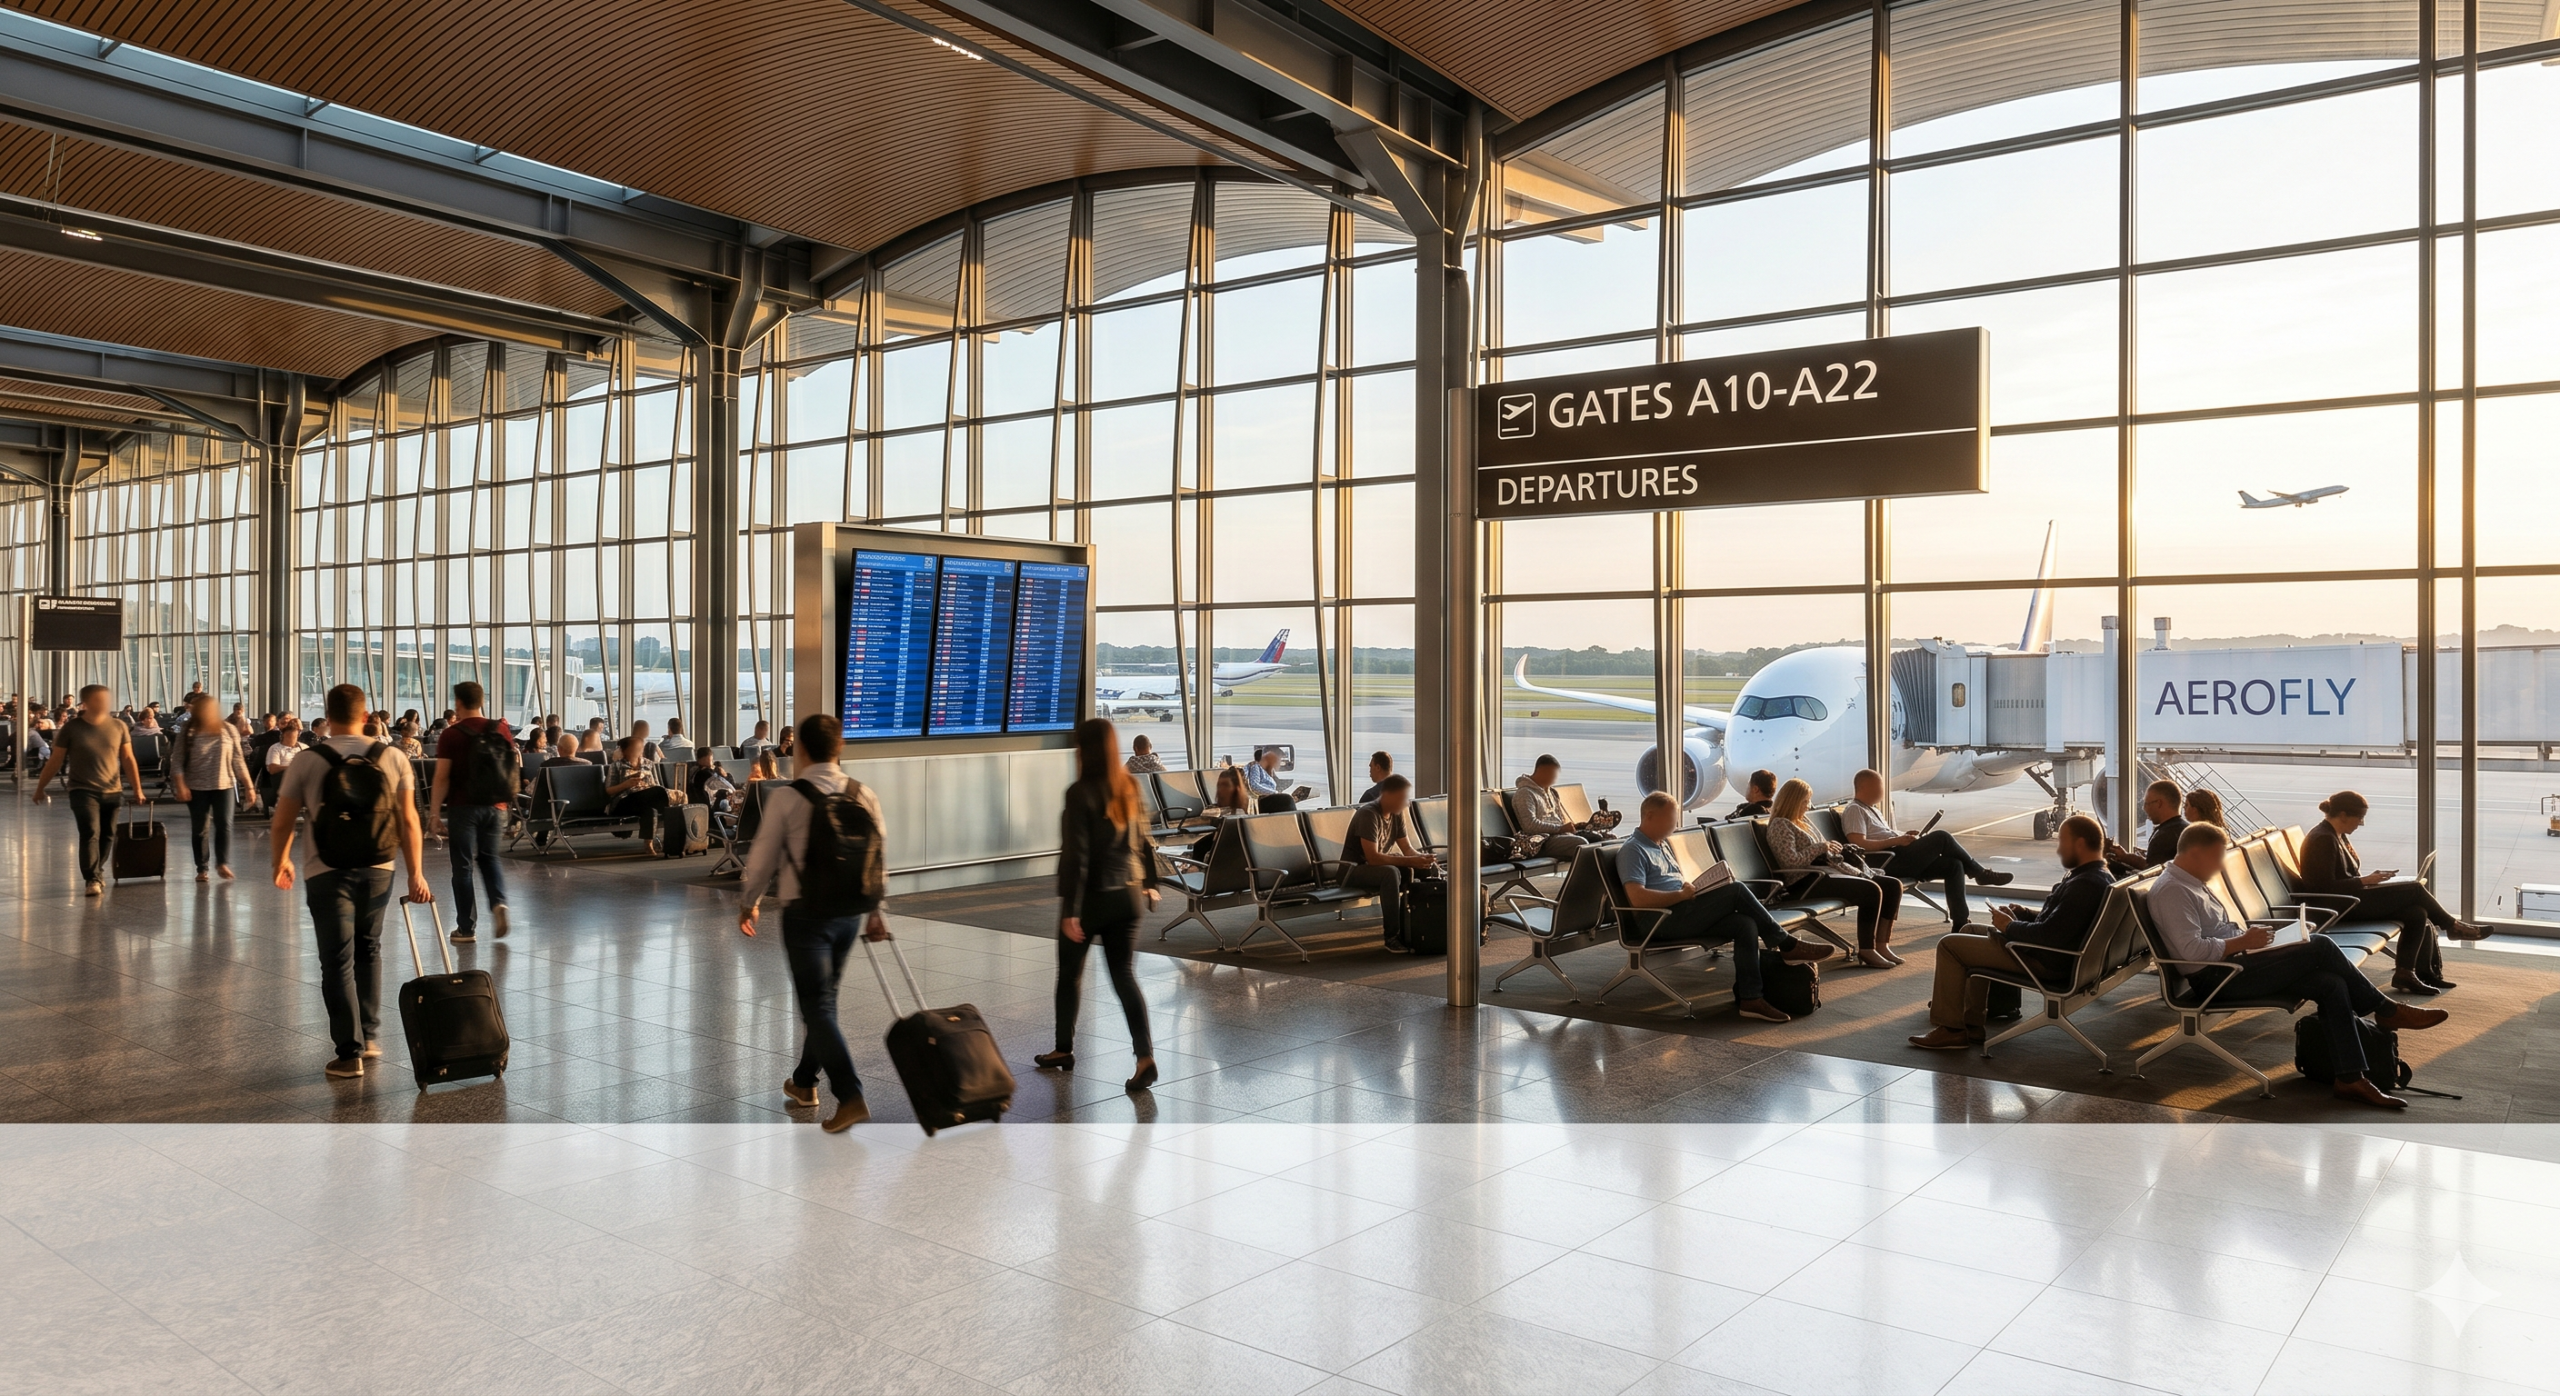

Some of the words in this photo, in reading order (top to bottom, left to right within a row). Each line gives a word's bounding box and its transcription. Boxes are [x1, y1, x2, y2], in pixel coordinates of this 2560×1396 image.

[1548, 382, 1673, 429] GATES
[1686, 359, 1879, 416] A10-A22
[1498, 464, 1699, 506] DEPARTURES
[2154, 678, 2357, 716] AEROFLY
